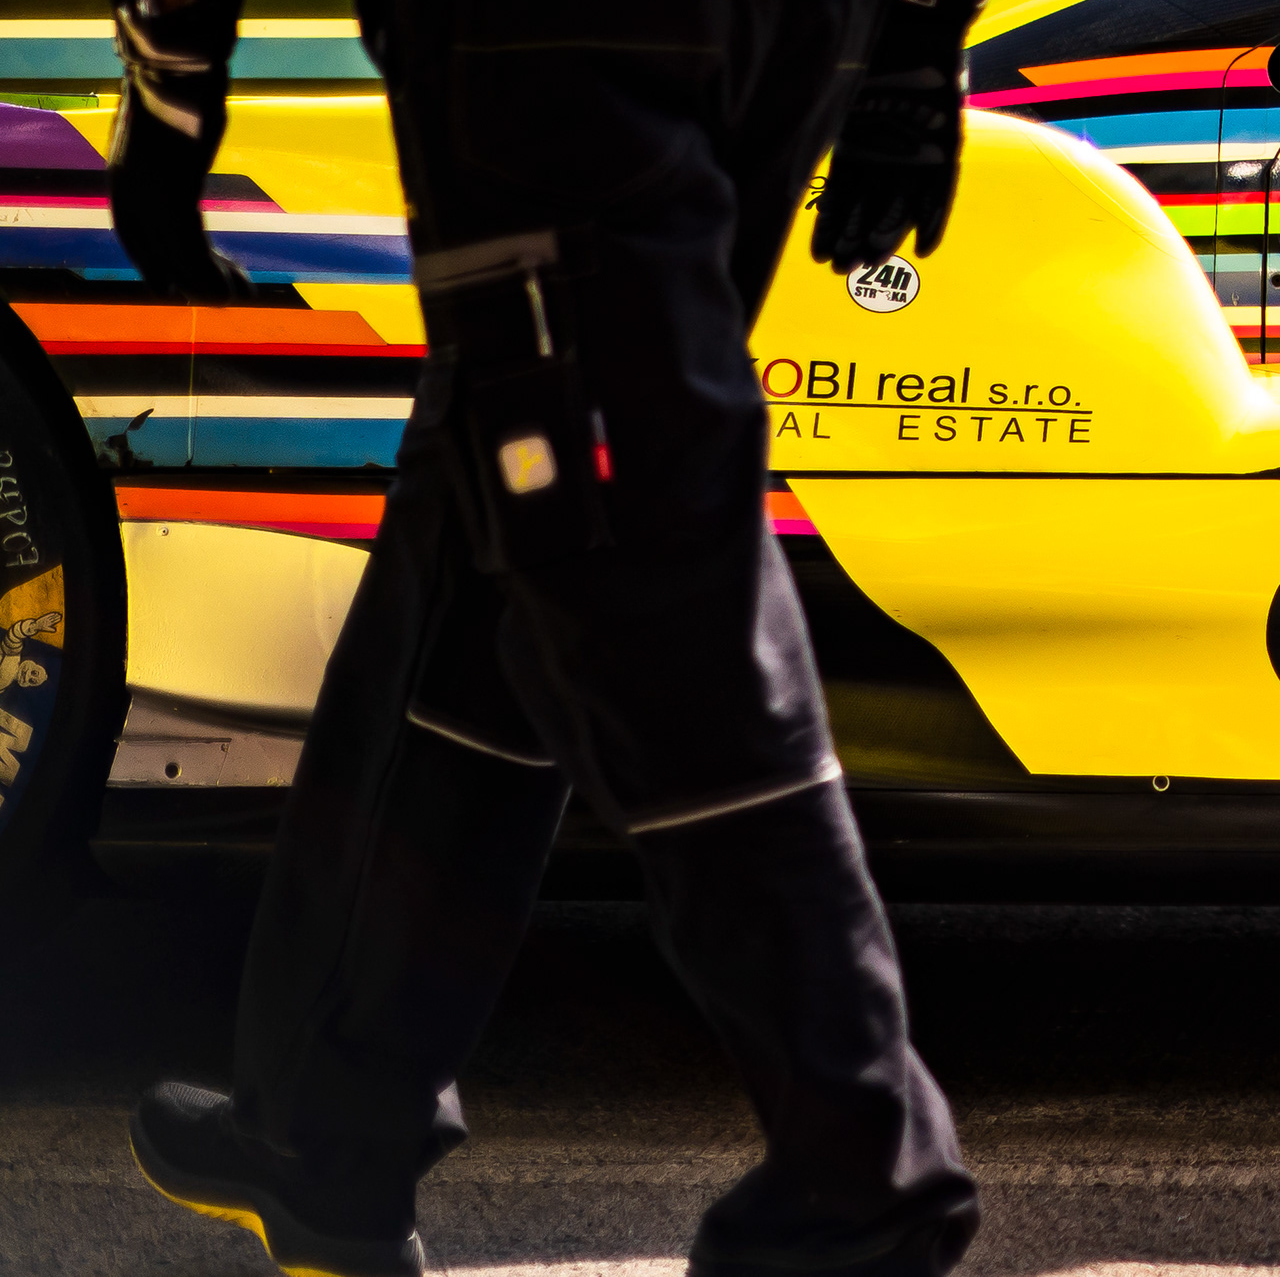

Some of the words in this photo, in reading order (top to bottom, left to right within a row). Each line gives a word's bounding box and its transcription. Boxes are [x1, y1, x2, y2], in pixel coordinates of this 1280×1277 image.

[857, 262, 913, 291] 24h
[752, 358, 857, 401] OBI
[877, 367, 971, 404] real
[988, 382, 1082, 407] s.r.o.
[897, 414, 1092, 444] ESTATE
